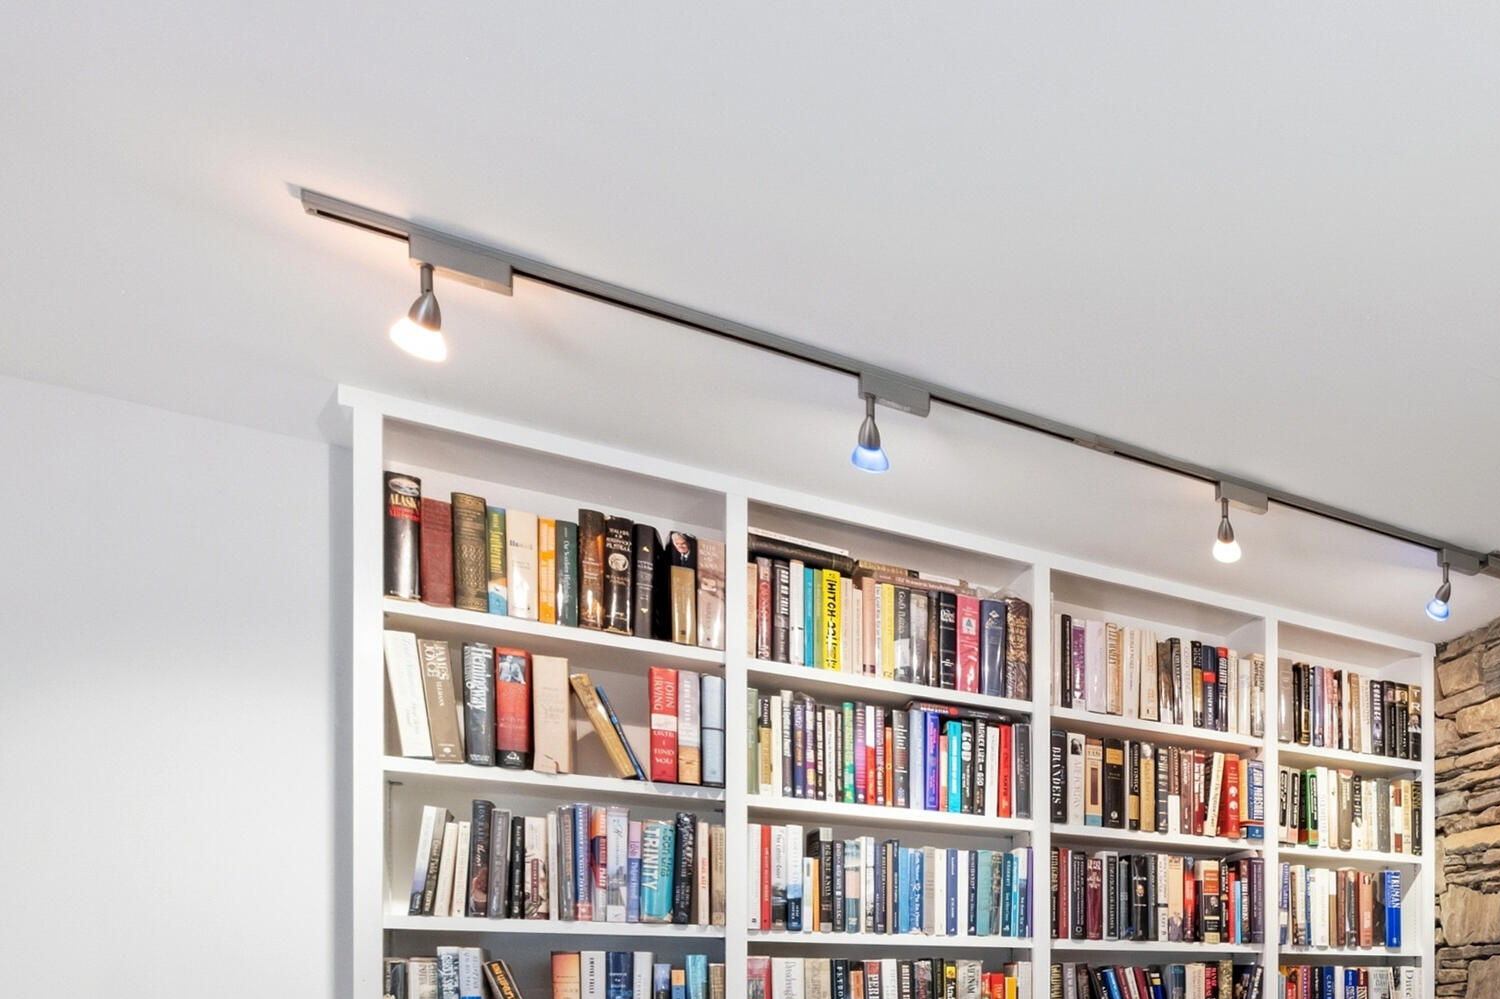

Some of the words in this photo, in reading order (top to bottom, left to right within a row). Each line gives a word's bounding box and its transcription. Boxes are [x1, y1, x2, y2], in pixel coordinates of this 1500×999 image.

[424, 645, 438, 678] JOYCE
[434, 645, 449, 681] JAMES
[466, 646, 491, 713] Hemingway
[653, 676, 664, 711] IRVING
[664, 681, 675, 709] JOHN
[655, 757, 676, 767] YOU
[1051, 746, 1066, 805] BRANDEIS
[1253, 787, 1264, 821] MARSHALL
[643, 828, 660, 891] TRINITY
[1390, 874, 1401, 908] TRUMAN
[966, 964, 976, 994] VIETNAM
